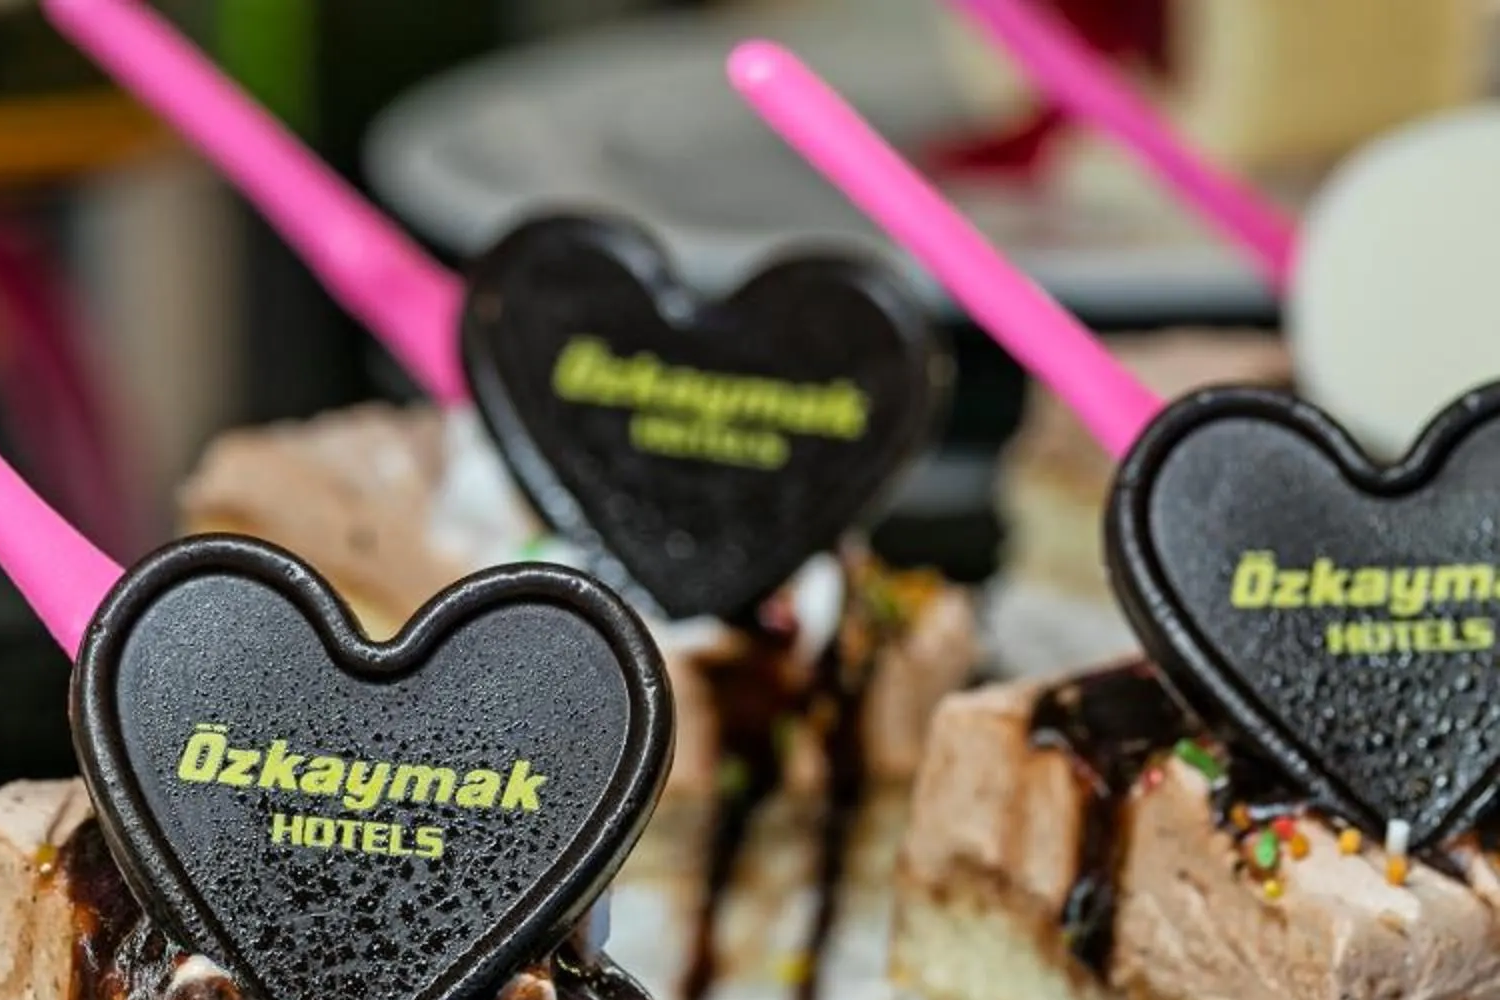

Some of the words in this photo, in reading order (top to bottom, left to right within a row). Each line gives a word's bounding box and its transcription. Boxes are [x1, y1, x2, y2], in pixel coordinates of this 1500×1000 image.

[1231, 550, 1500, 616] Özkaym
[1325, 618, 1495, 655] HOTELS
[177, 723, 548, 811] Özkaymak
[271, 813, 445, 859] HOTELS
